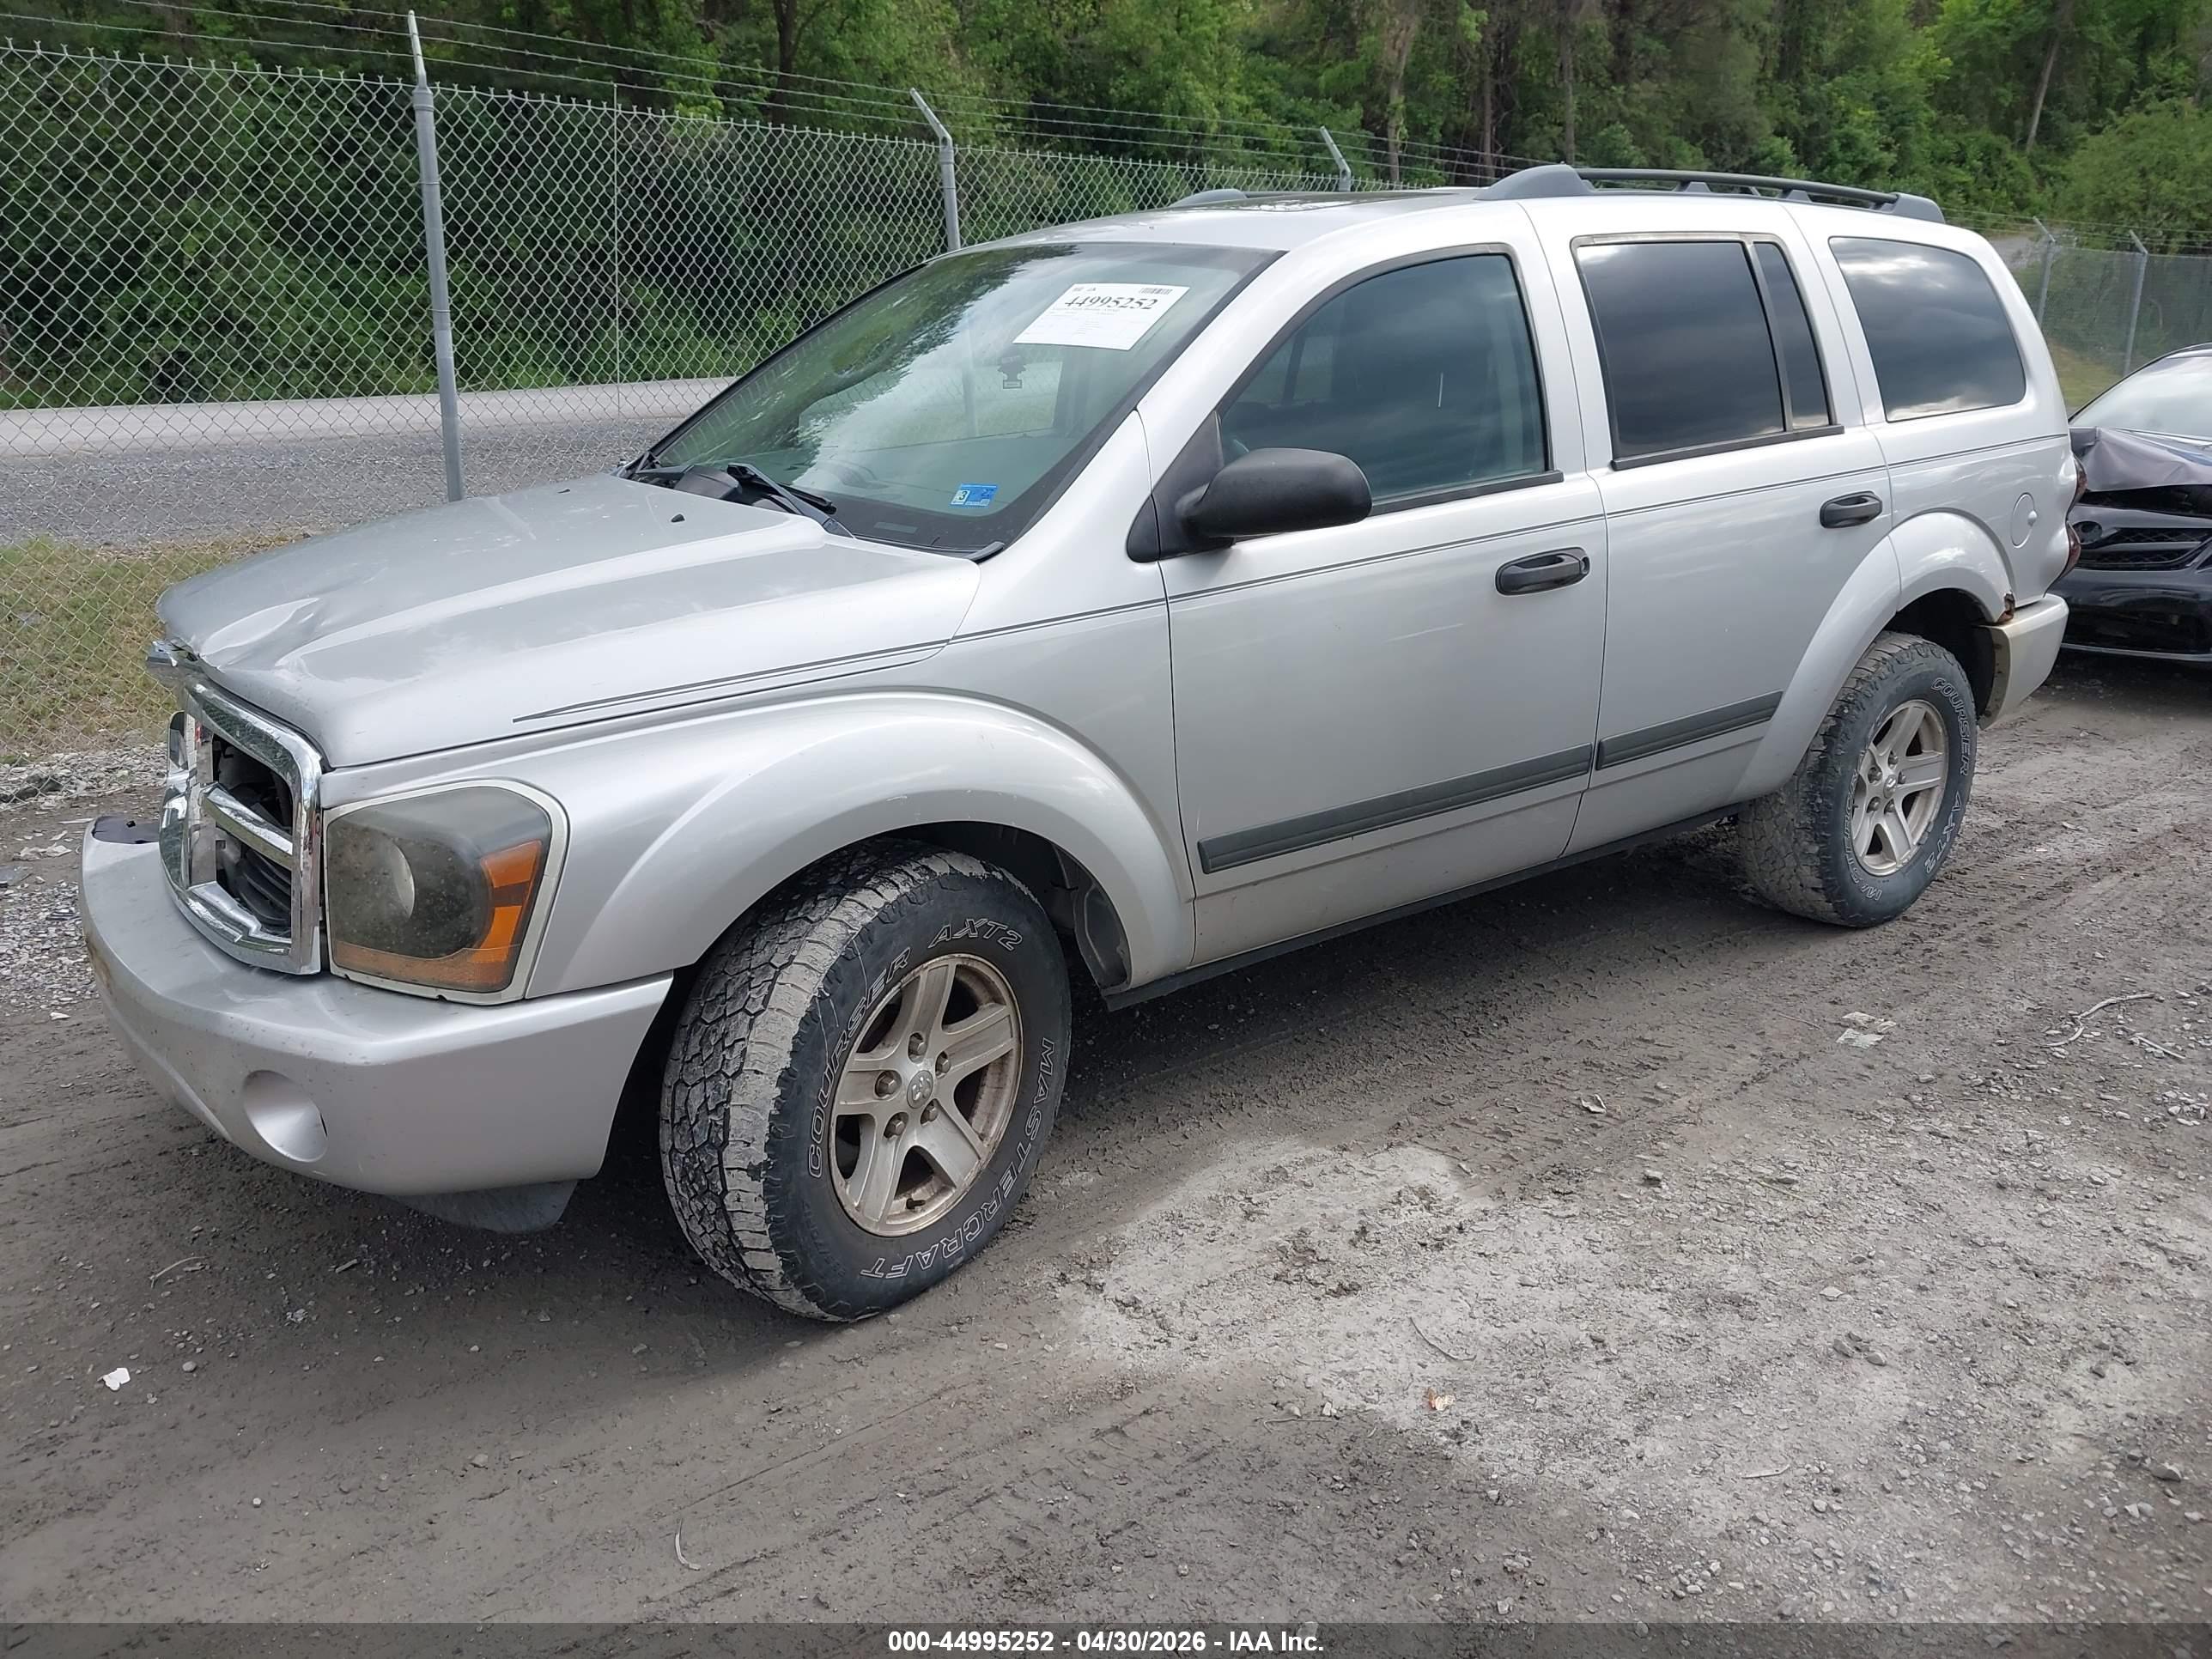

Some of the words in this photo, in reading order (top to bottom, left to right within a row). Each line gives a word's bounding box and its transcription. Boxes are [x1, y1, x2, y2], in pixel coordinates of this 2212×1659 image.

[1065, 295, 1158, 310] 44995252
[1931, 678, 1969, 776] COURSER
[1924, 791, 1963, 874] AXT2
[807, 946, 912, 1179] COURSER
[927, 918, 1024, 952] AXT2
[860, 1036, 1055, 1280] MASTERCRAFT
